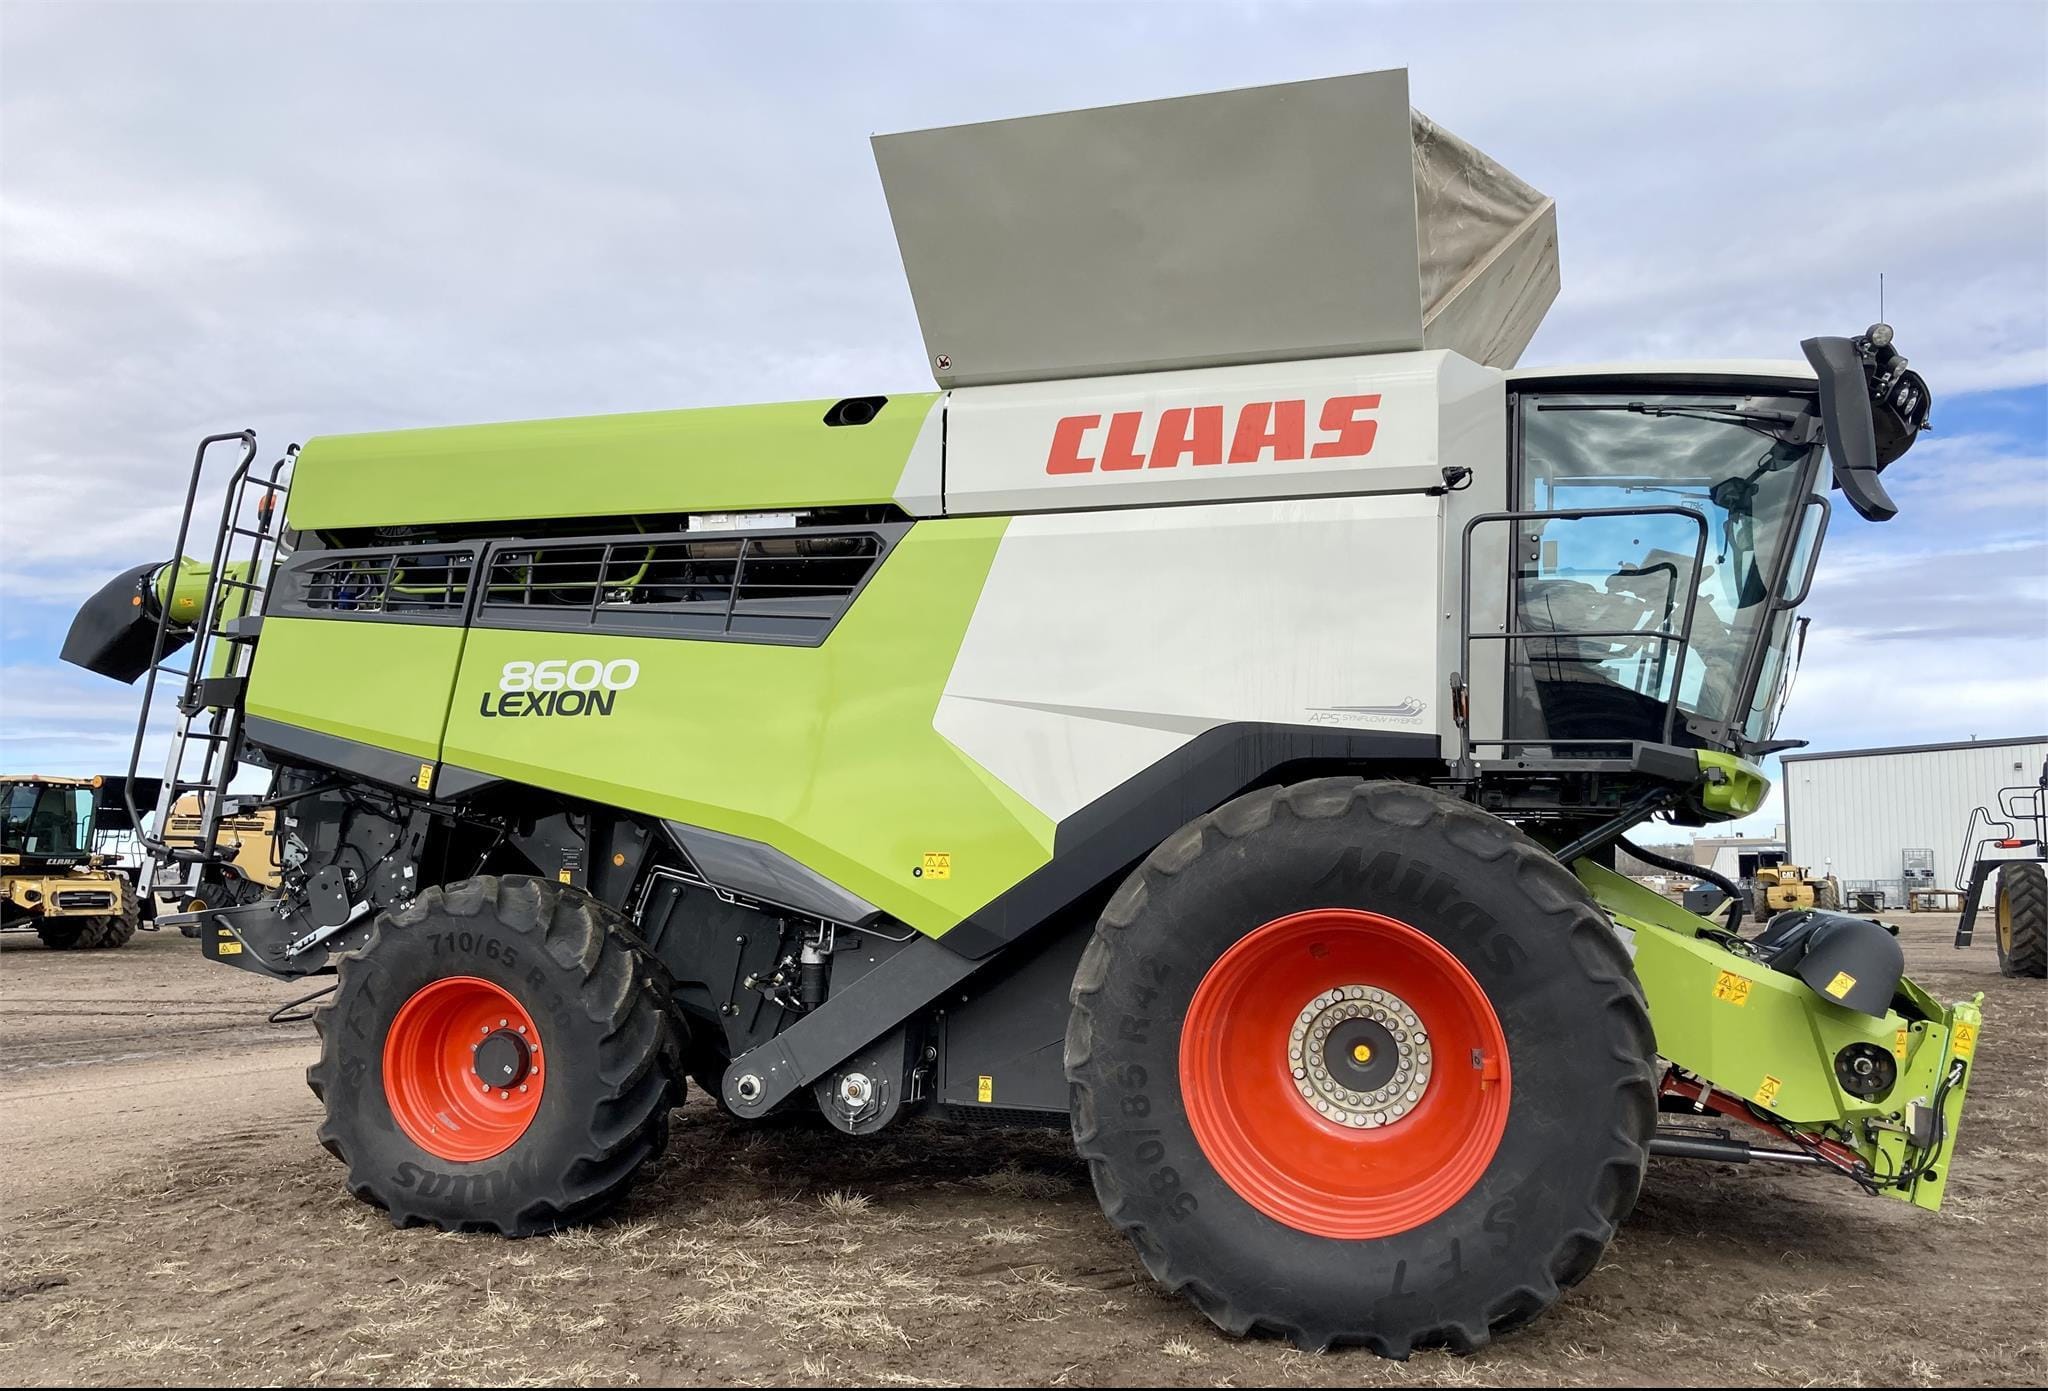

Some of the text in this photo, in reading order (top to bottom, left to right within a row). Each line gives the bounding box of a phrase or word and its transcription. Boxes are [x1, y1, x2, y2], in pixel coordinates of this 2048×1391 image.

[1045, 393, 1382, 475] CLAAS
[499, 658, 640, 692] 8600
[480, 689, 617, 717] LEXION
[1308, 712, 1340, 724] APS
[1781, 871, 1795, 879] CAT
[1310, 846, 1528, 976] Mitas
[427, 931, 519, 969] 710/65
[1117, 1064, 1198, 1223] 580/85
